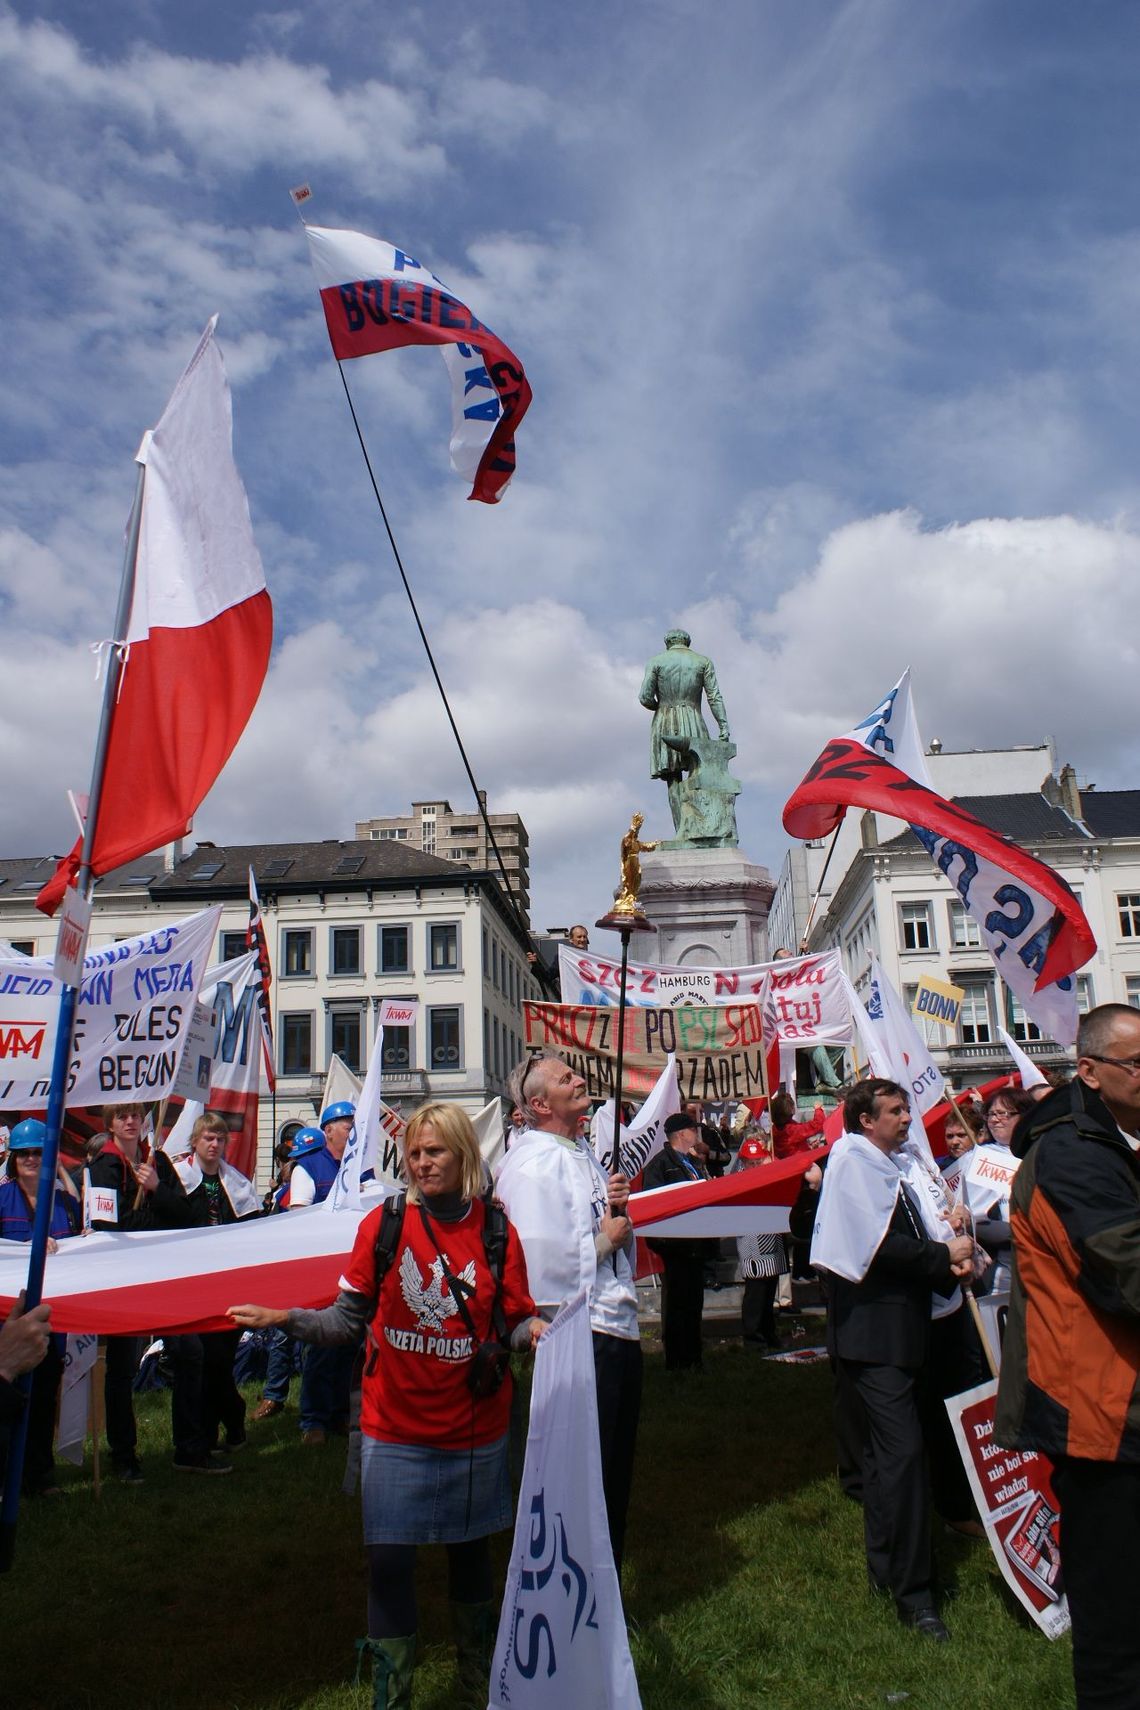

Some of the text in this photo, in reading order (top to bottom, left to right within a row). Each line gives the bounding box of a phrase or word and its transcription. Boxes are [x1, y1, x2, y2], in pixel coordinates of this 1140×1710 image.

[660, 976, 710, 988] HAMBURG
[917, 988, 959, 1023] BONN
[523, 1004, 597, 1051] PRECZ
[777, 1021, 817, 1039] as
[99, 1051, 176, 1091] BEGUN
